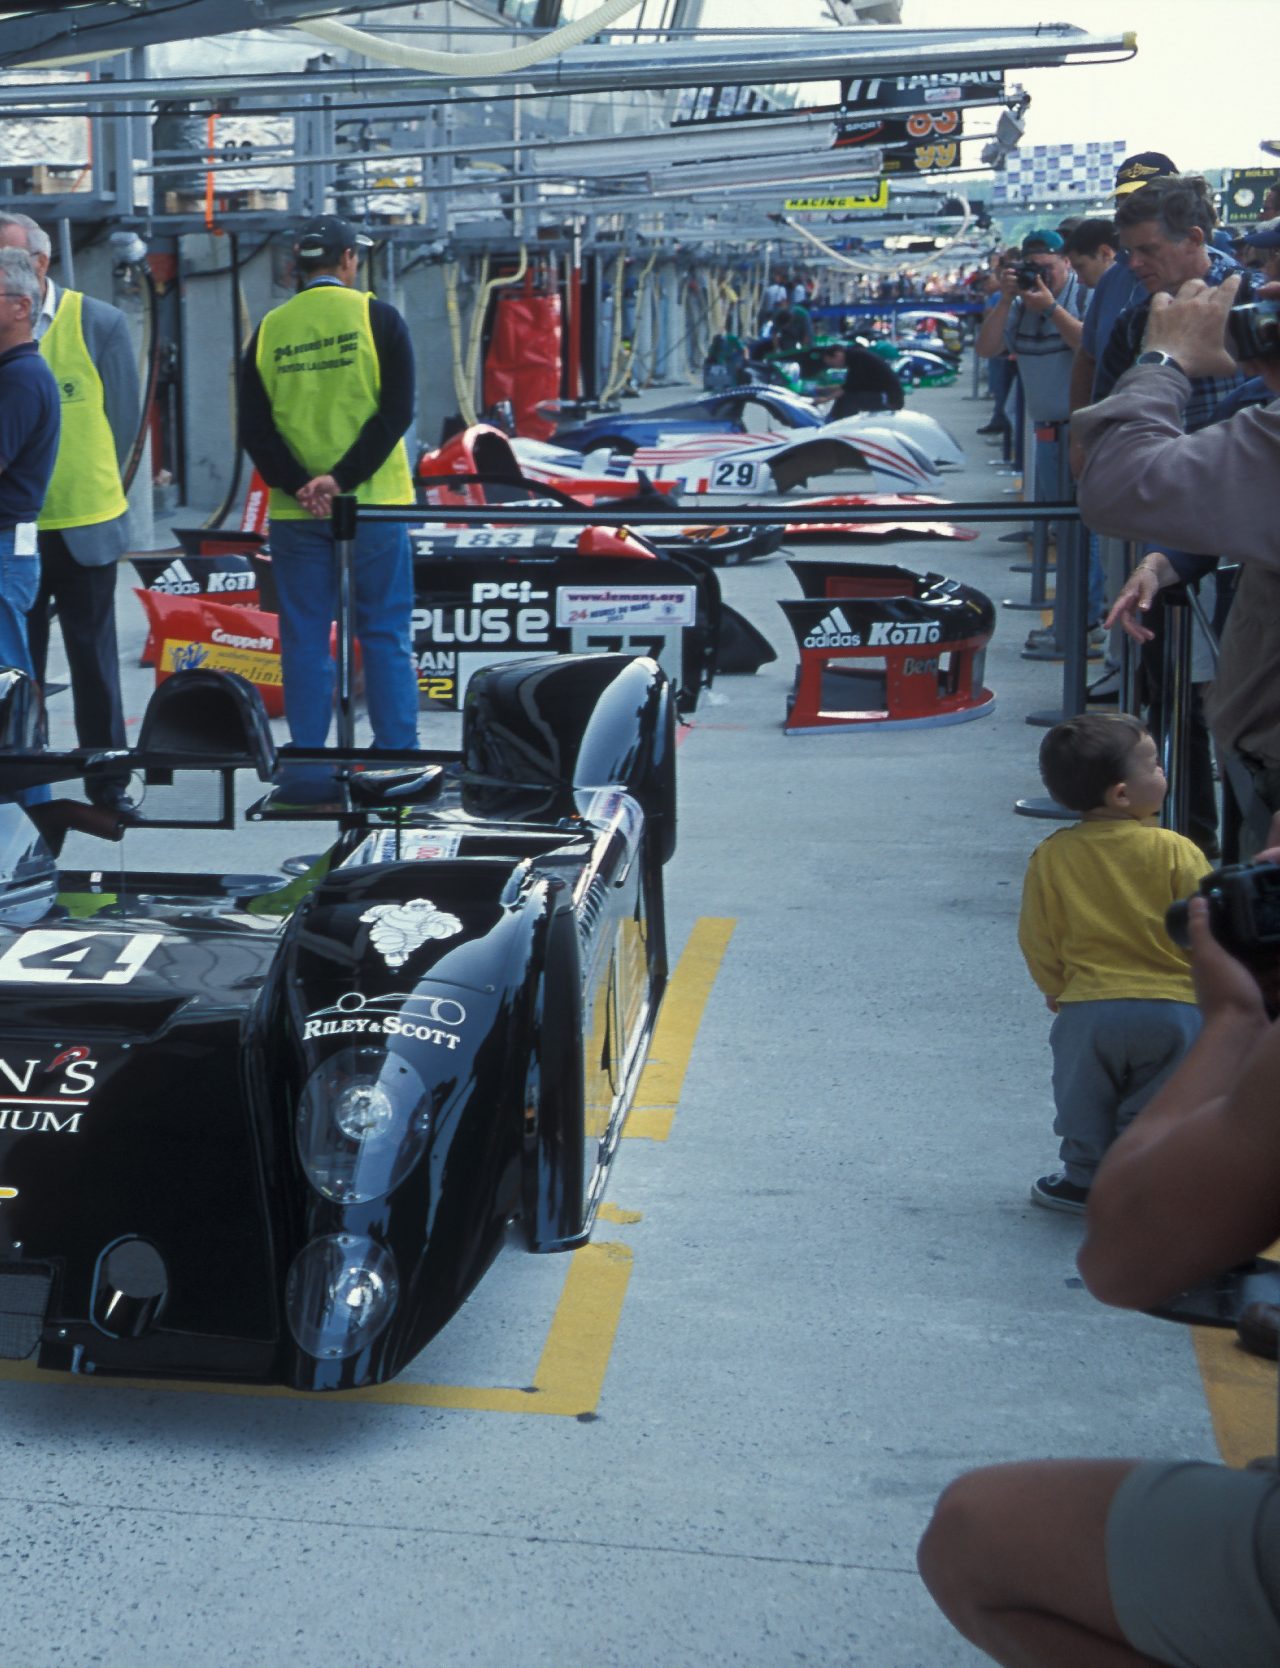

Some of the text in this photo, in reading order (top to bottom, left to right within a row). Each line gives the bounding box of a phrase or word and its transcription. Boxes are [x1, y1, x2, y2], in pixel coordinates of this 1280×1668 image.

[716, 463, 755, 486] 29
[469, 533, 521, 545] 83
[567, 592, 685, 603] www.lemans.org
[568, 609, 588, 622] 24
[803, 632, 861, 648] adidas
[18, 933, 137, 981] 4
